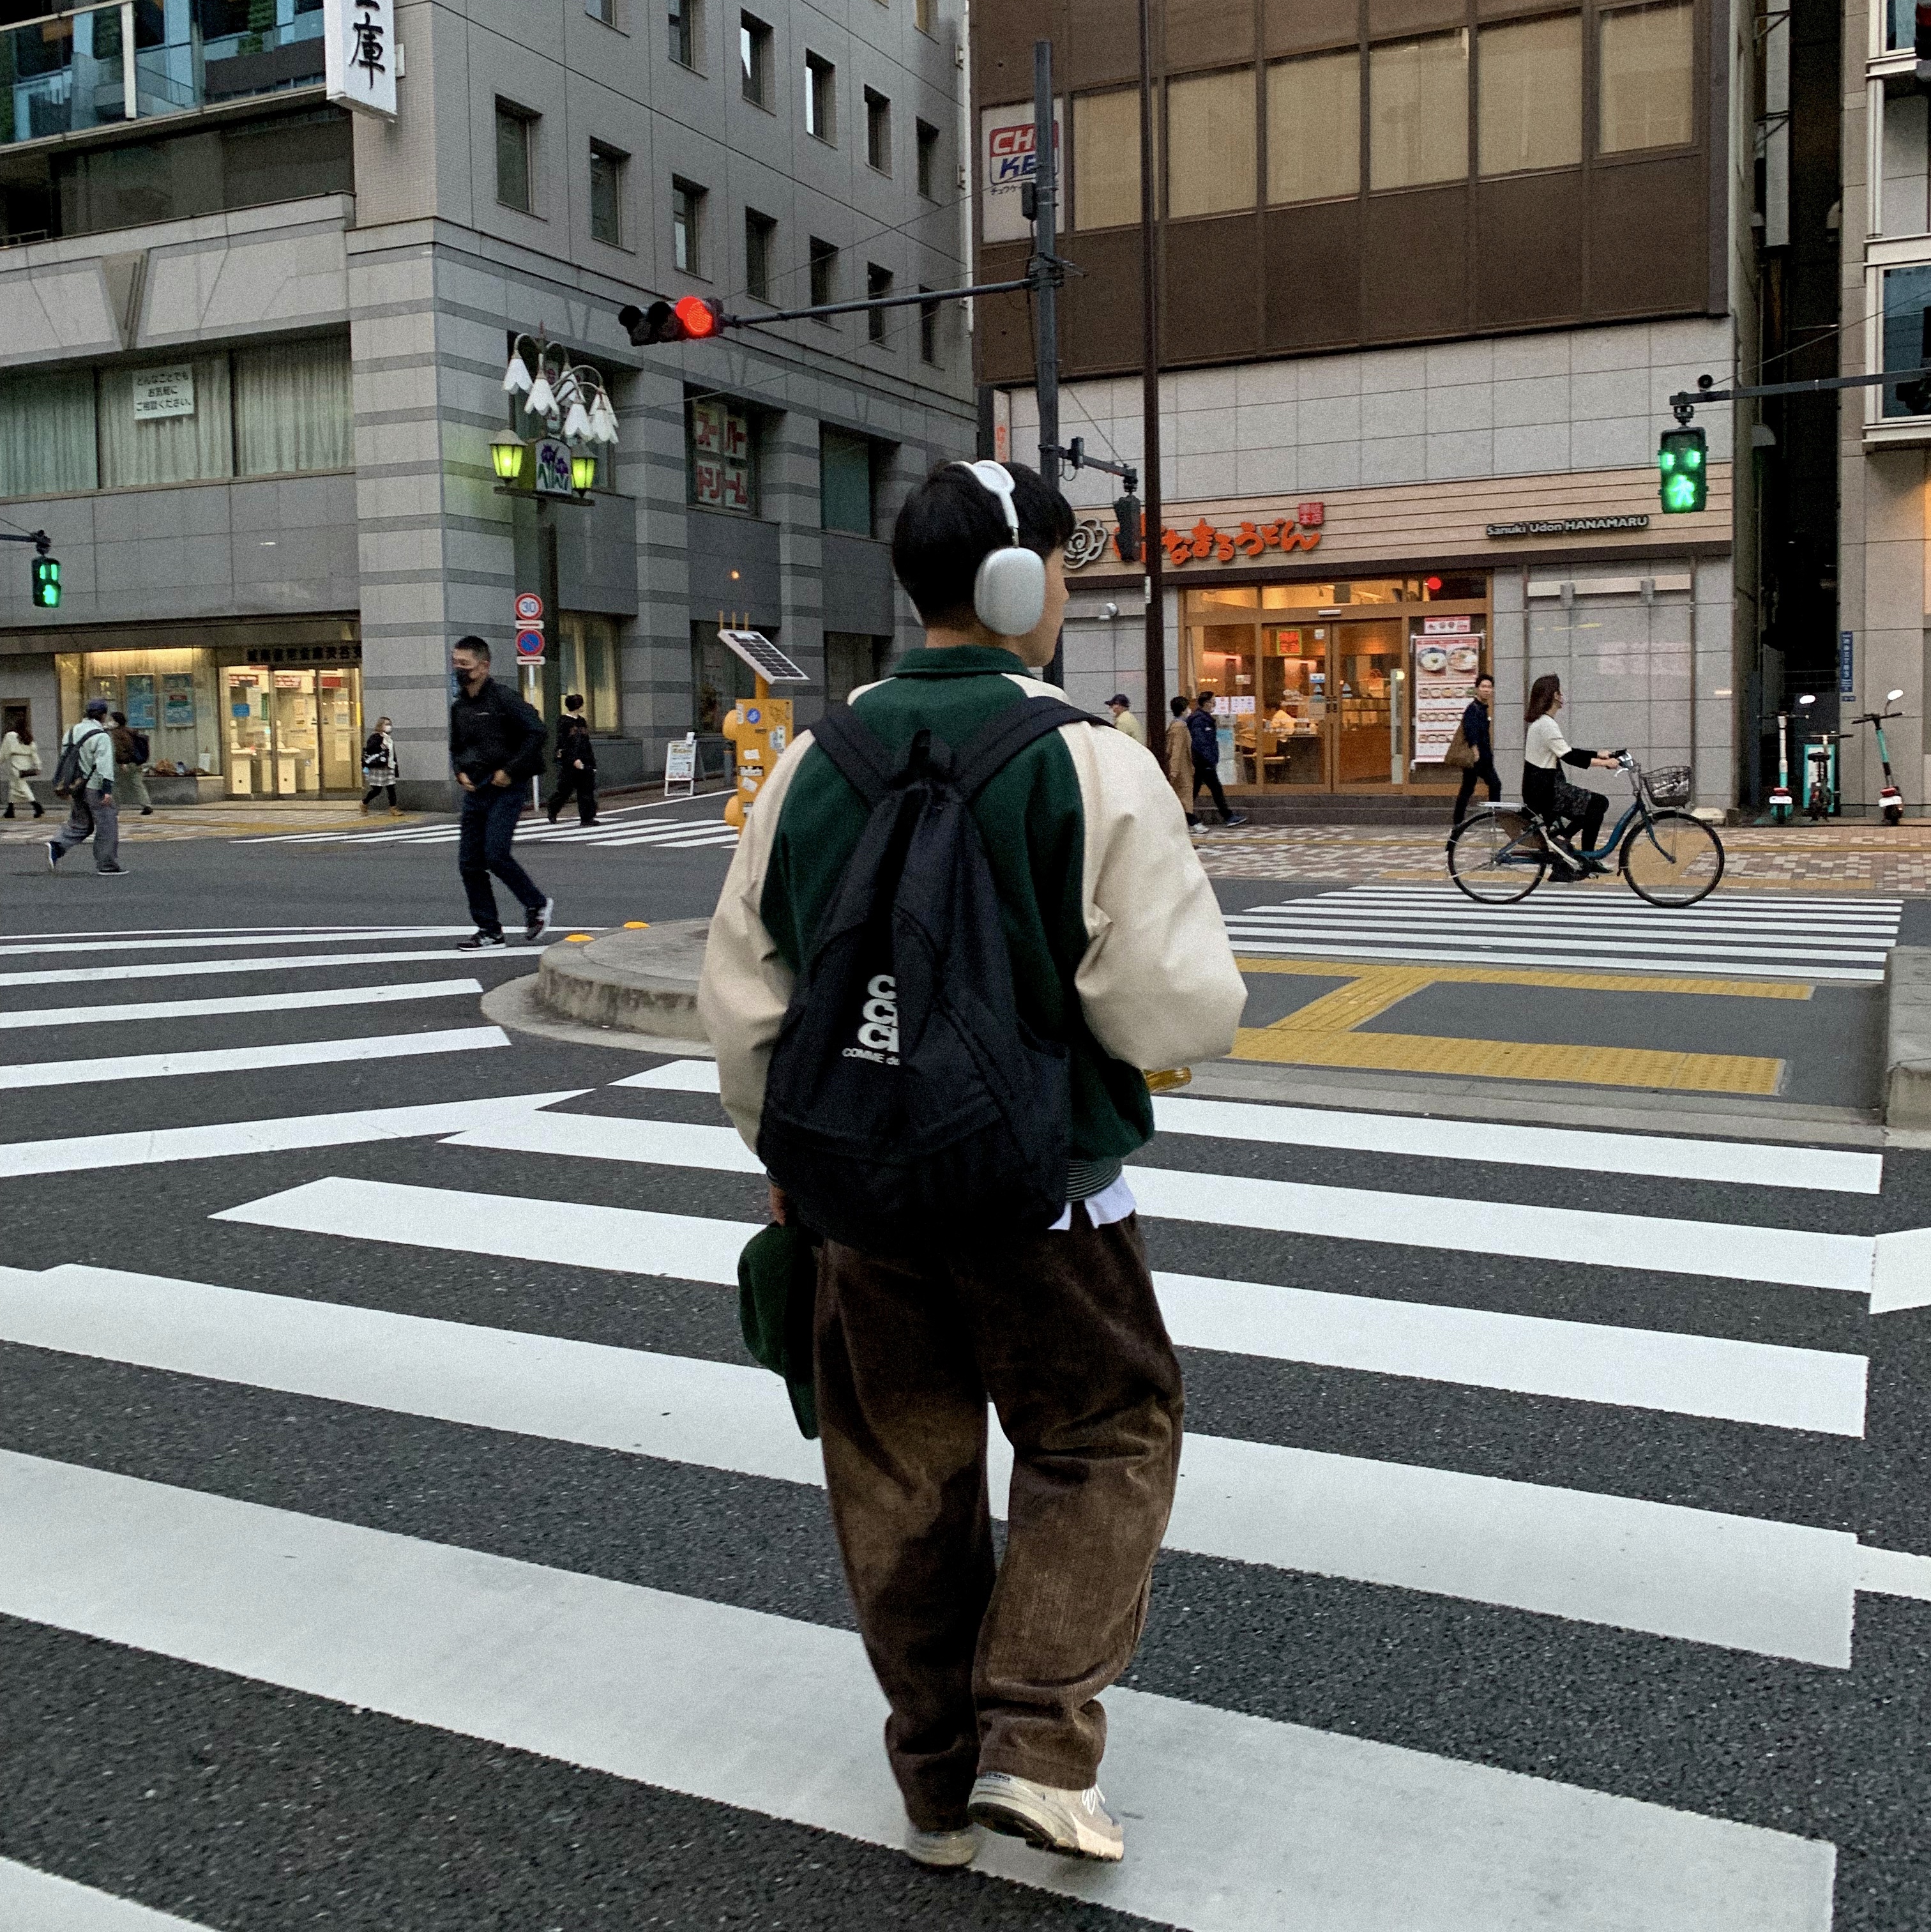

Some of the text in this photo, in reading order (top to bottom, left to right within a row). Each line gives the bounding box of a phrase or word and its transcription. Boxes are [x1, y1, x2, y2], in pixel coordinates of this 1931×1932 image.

[992, 128, 1036, 155] CH
[1487, 516, 1648, 535] Sanuki Udon HANAMARU
[522, 601, 536, 613] 30
[842, 1047, 900, 1066] COMME de
